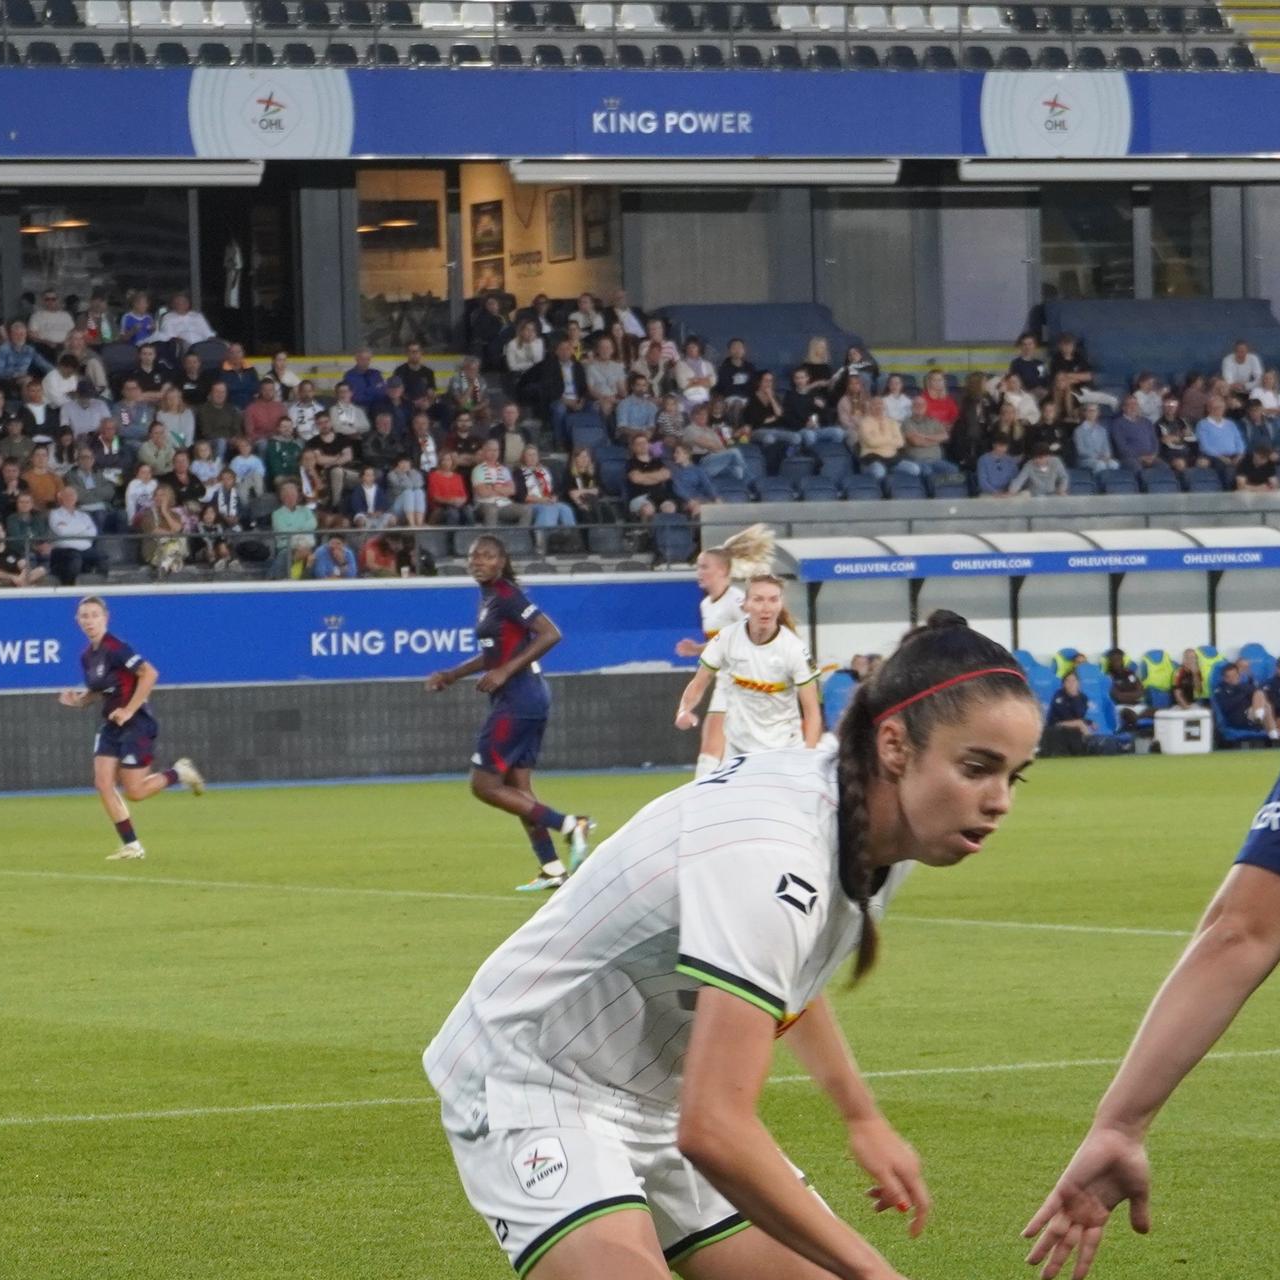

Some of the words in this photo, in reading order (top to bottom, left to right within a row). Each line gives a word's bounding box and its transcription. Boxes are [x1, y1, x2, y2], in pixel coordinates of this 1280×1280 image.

[258, 118, 285, 131] OHL
[591, 111, 658, 134] KING
[664, 111, 753, 134] POWER
[1044, 119, 1068, 131] OHL
[951, 558, 1033, 571] OHLEUVEN.COM
[1068, 555, 1147, 567] OHLEUVEN.COM
[1183, 552, 1261, 565] OHLEUVEN.COM
[833, 560, 916, 575] OHLEUVEN.COM
[311, 630, 386, 657] KING
[394, 628, 477, 655] POWE
[526, 1178, 536, 1189] OH
[537, 1162, 564, 1182] LEUVEN
